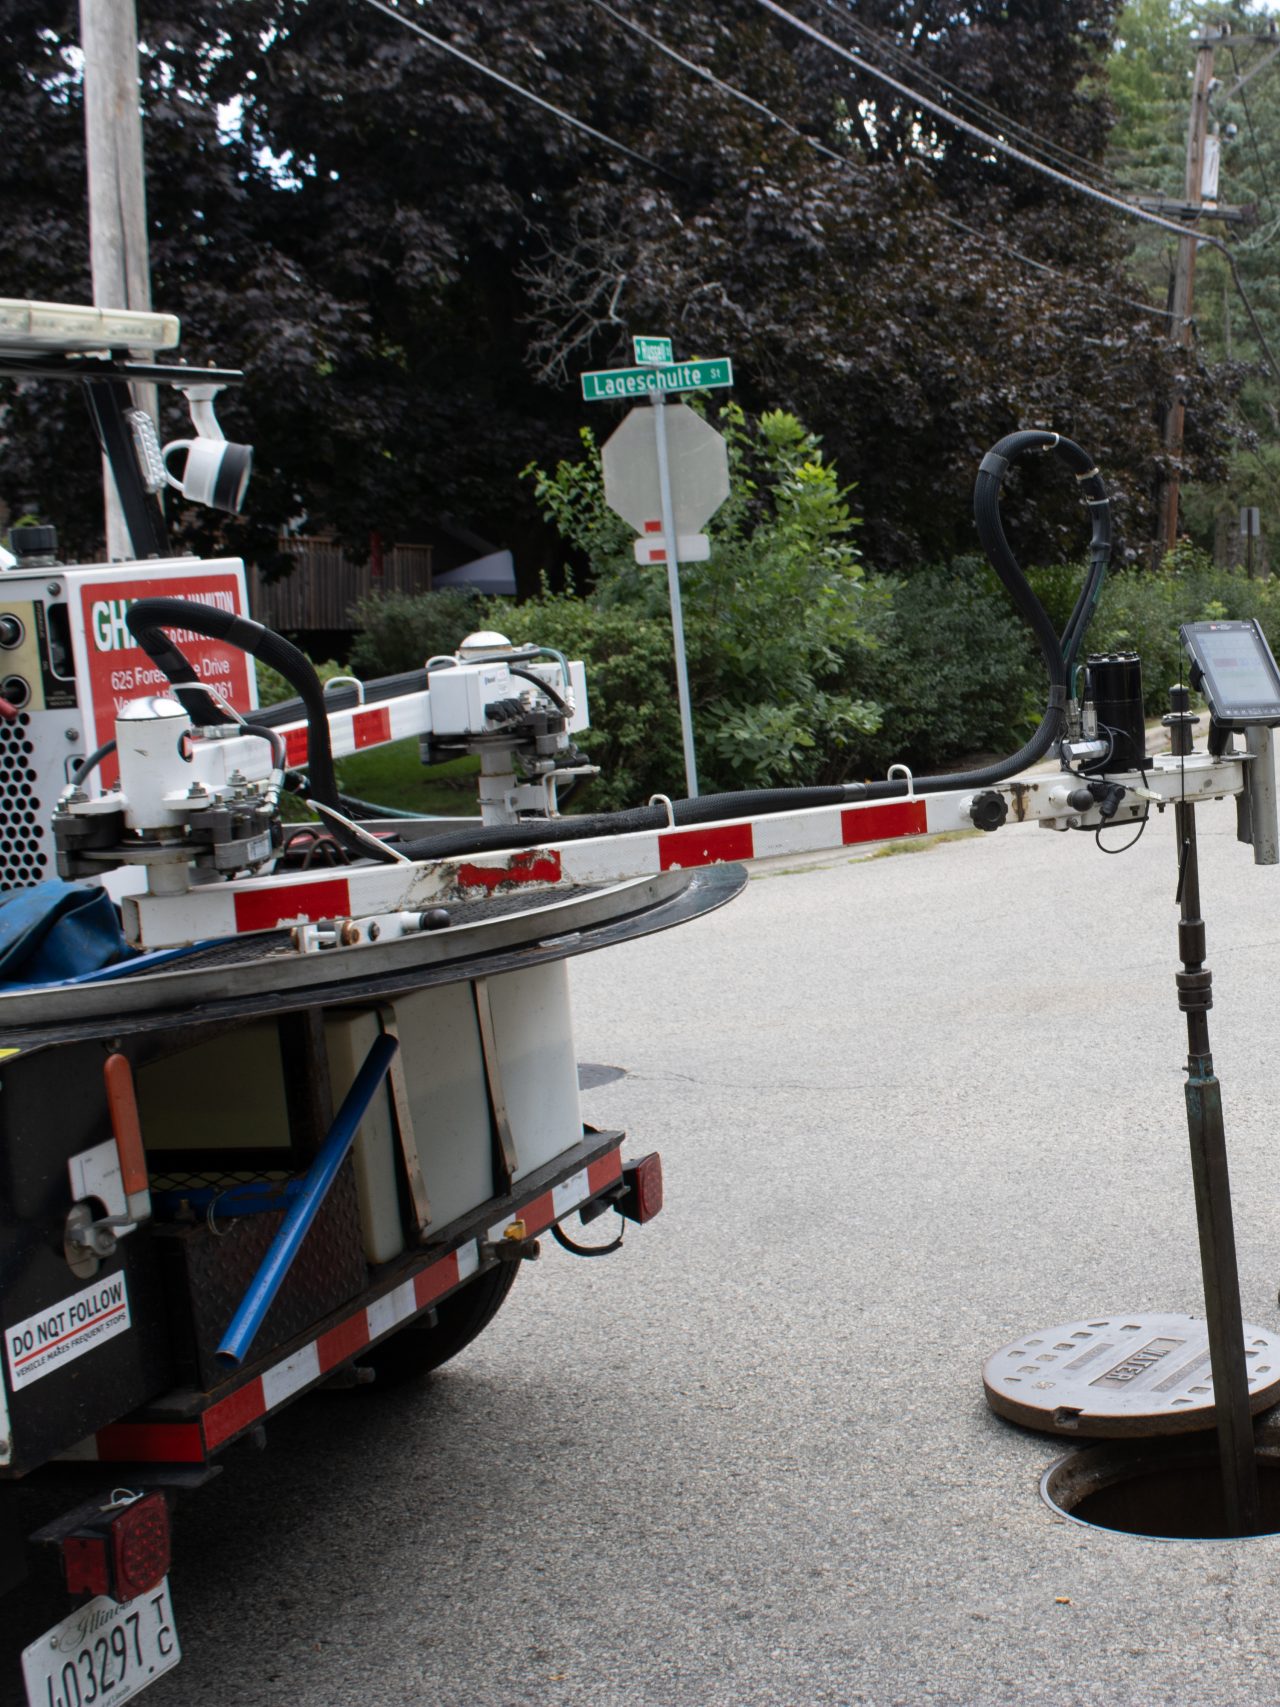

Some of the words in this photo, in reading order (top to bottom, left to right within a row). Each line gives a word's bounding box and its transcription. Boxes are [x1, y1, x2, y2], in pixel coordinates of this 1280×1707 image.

[594, 367, 702, 396] Lageschulte
[710, 368, 721, 379] St
[92, 598, 139, 652] GH
[111, 672, 134, 691] 625
[135, 667, 168, 685] Fores
[202, 658, 230, 677] Drive
[12, 1329, 34, 1358] DO
[37, 1311, 65, 1344] NOT
[69, 1281, 122, 1327] FOLLOW
[15, 1356, 46, 1378] VEHICLE
[47, 1342, 70, 1361] MAKES
[71, 1324, 105, 1349] FREQUENT
[105, 1312, 127, 1329] STOPS
[1106, 1348, 1171, 1382] WATER
